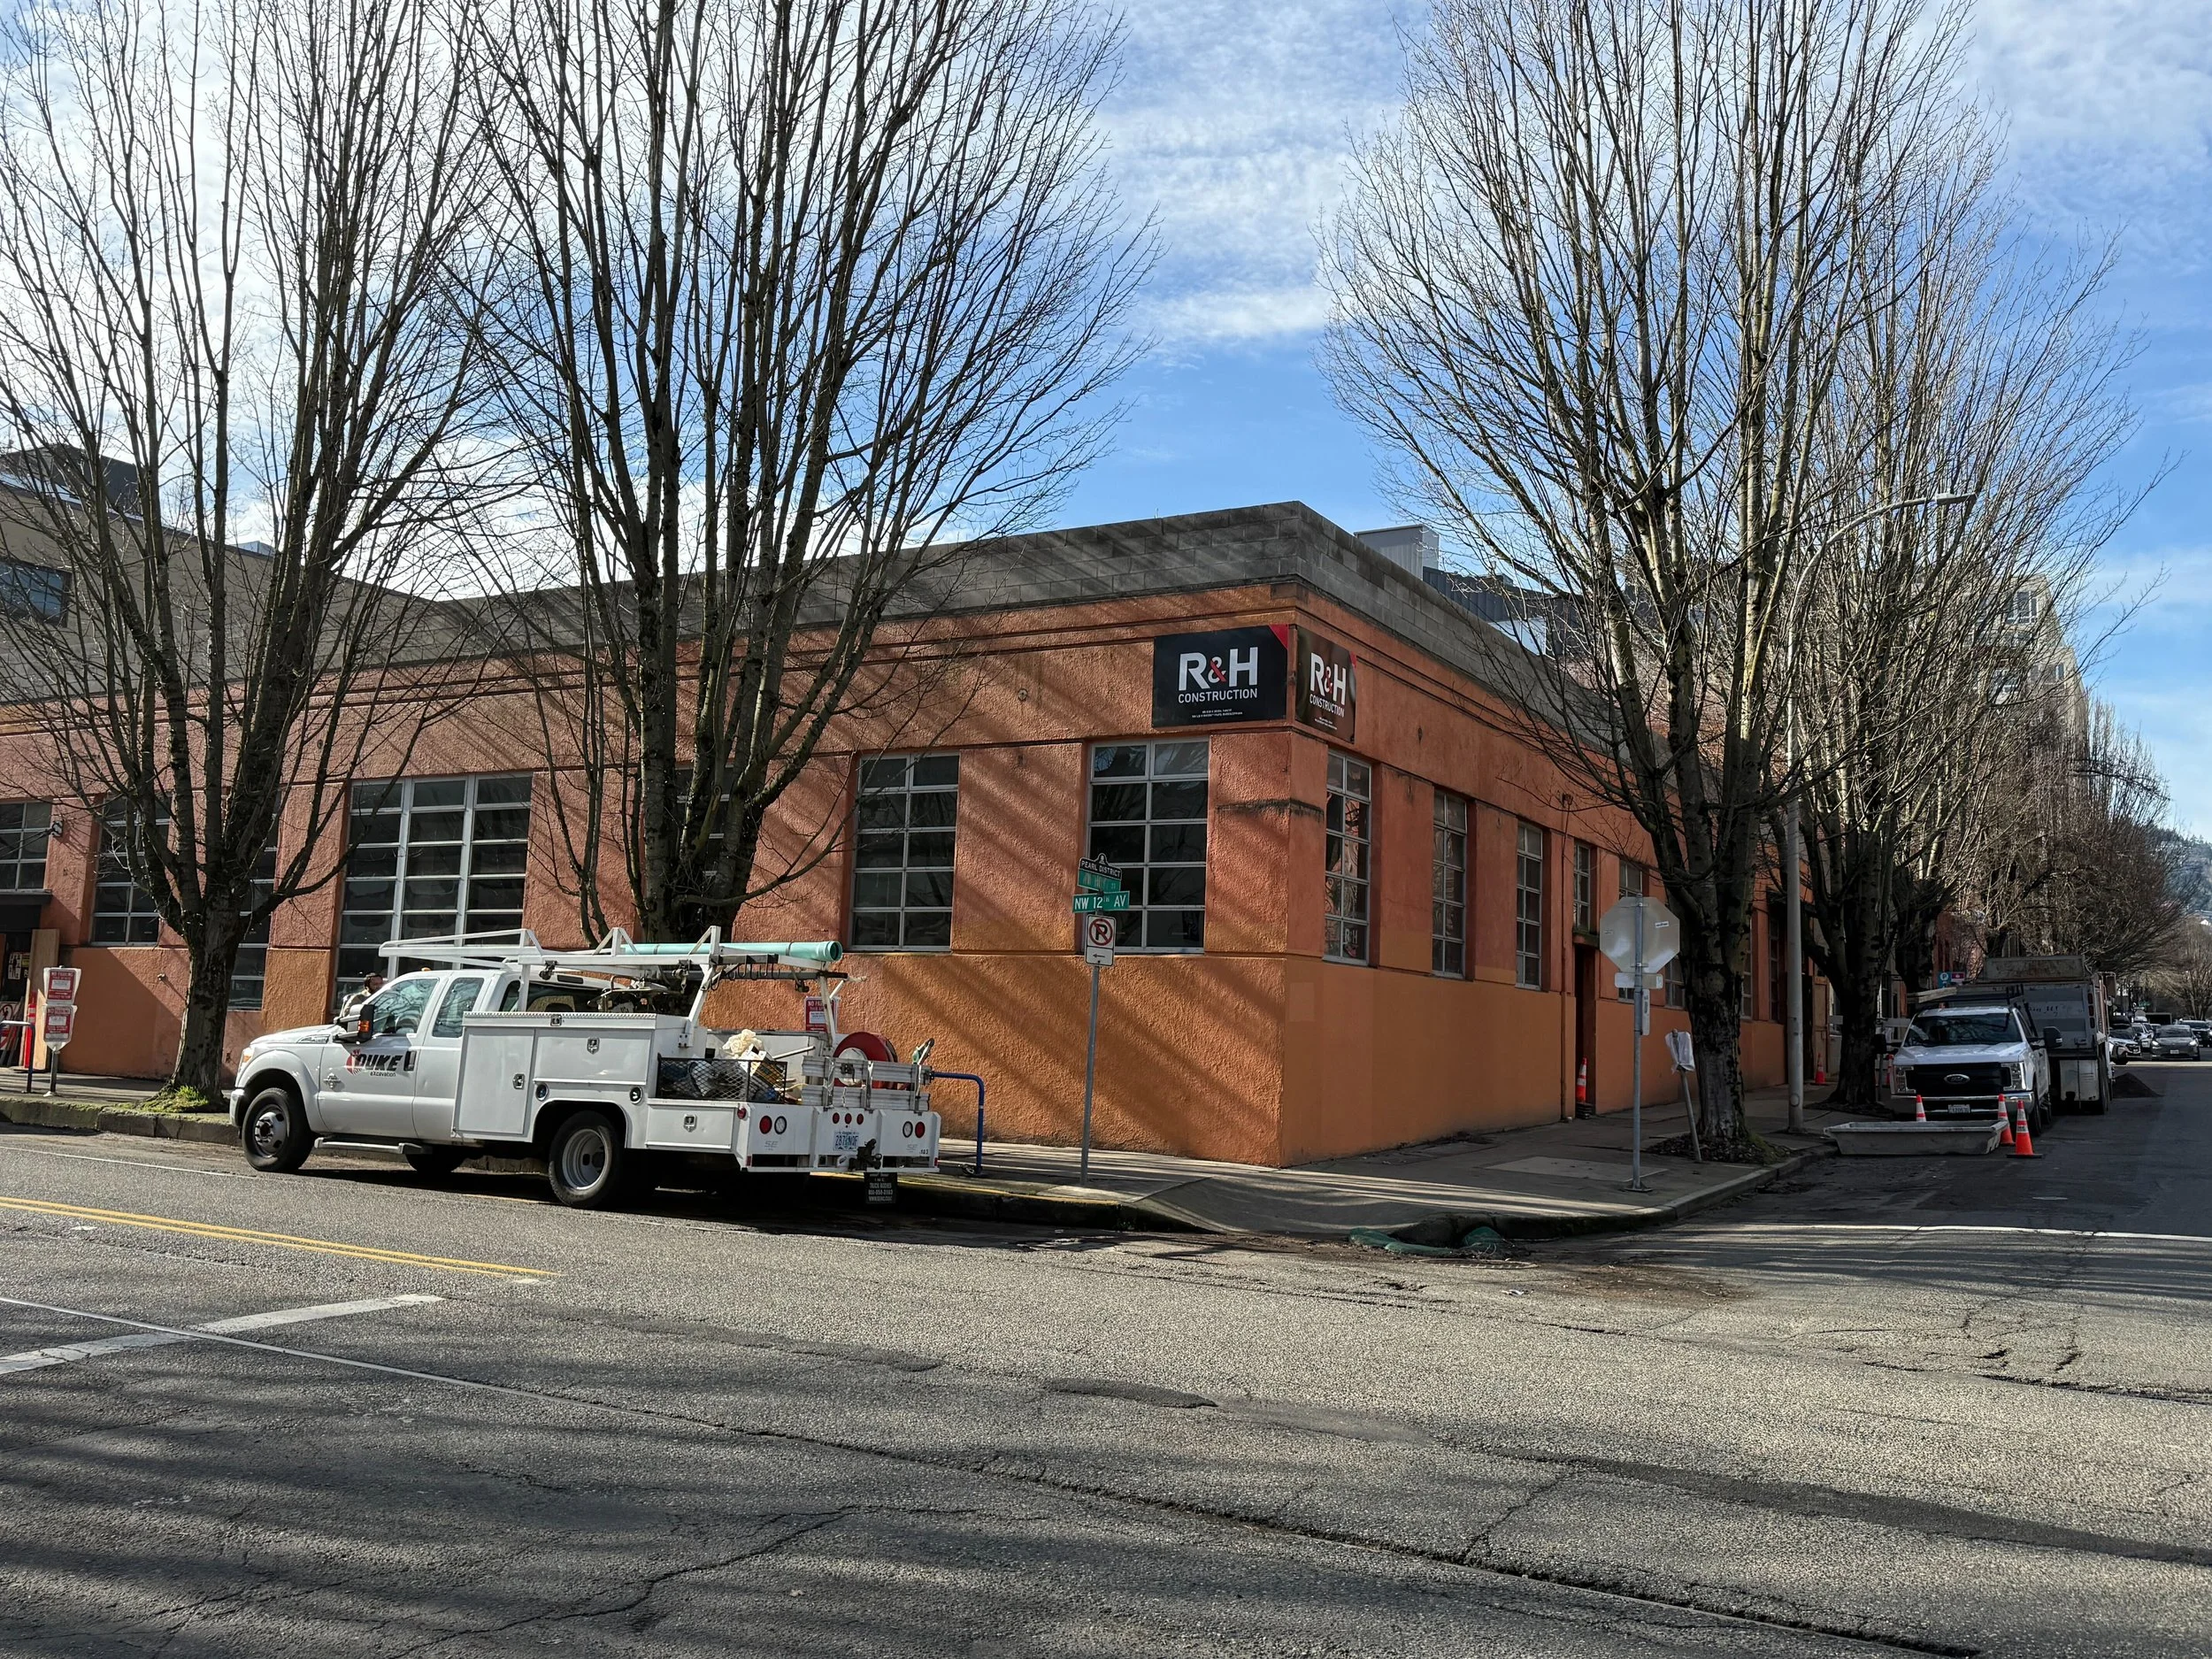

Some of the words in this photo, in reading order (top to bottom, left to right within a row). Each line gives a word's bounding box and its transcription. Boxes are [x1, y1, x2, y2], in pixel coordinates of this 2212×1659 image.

[1179, 647, 1258, 691] R&H
[1310, 652, 1347, 705] R&H
[1178, 687, 1258, 704] CONSTRUCTION
[1310, 693, 1345, 718] CONSTRUCTION
[1080, 860, 1098, 872] PEARL
[1099, 864, 1121, 878] DISTRICT
[1074, 897, 1089, 910] NW
[1114, 895, 1126, 907] AV
[356, 1054, 403, 1071] DUKE
